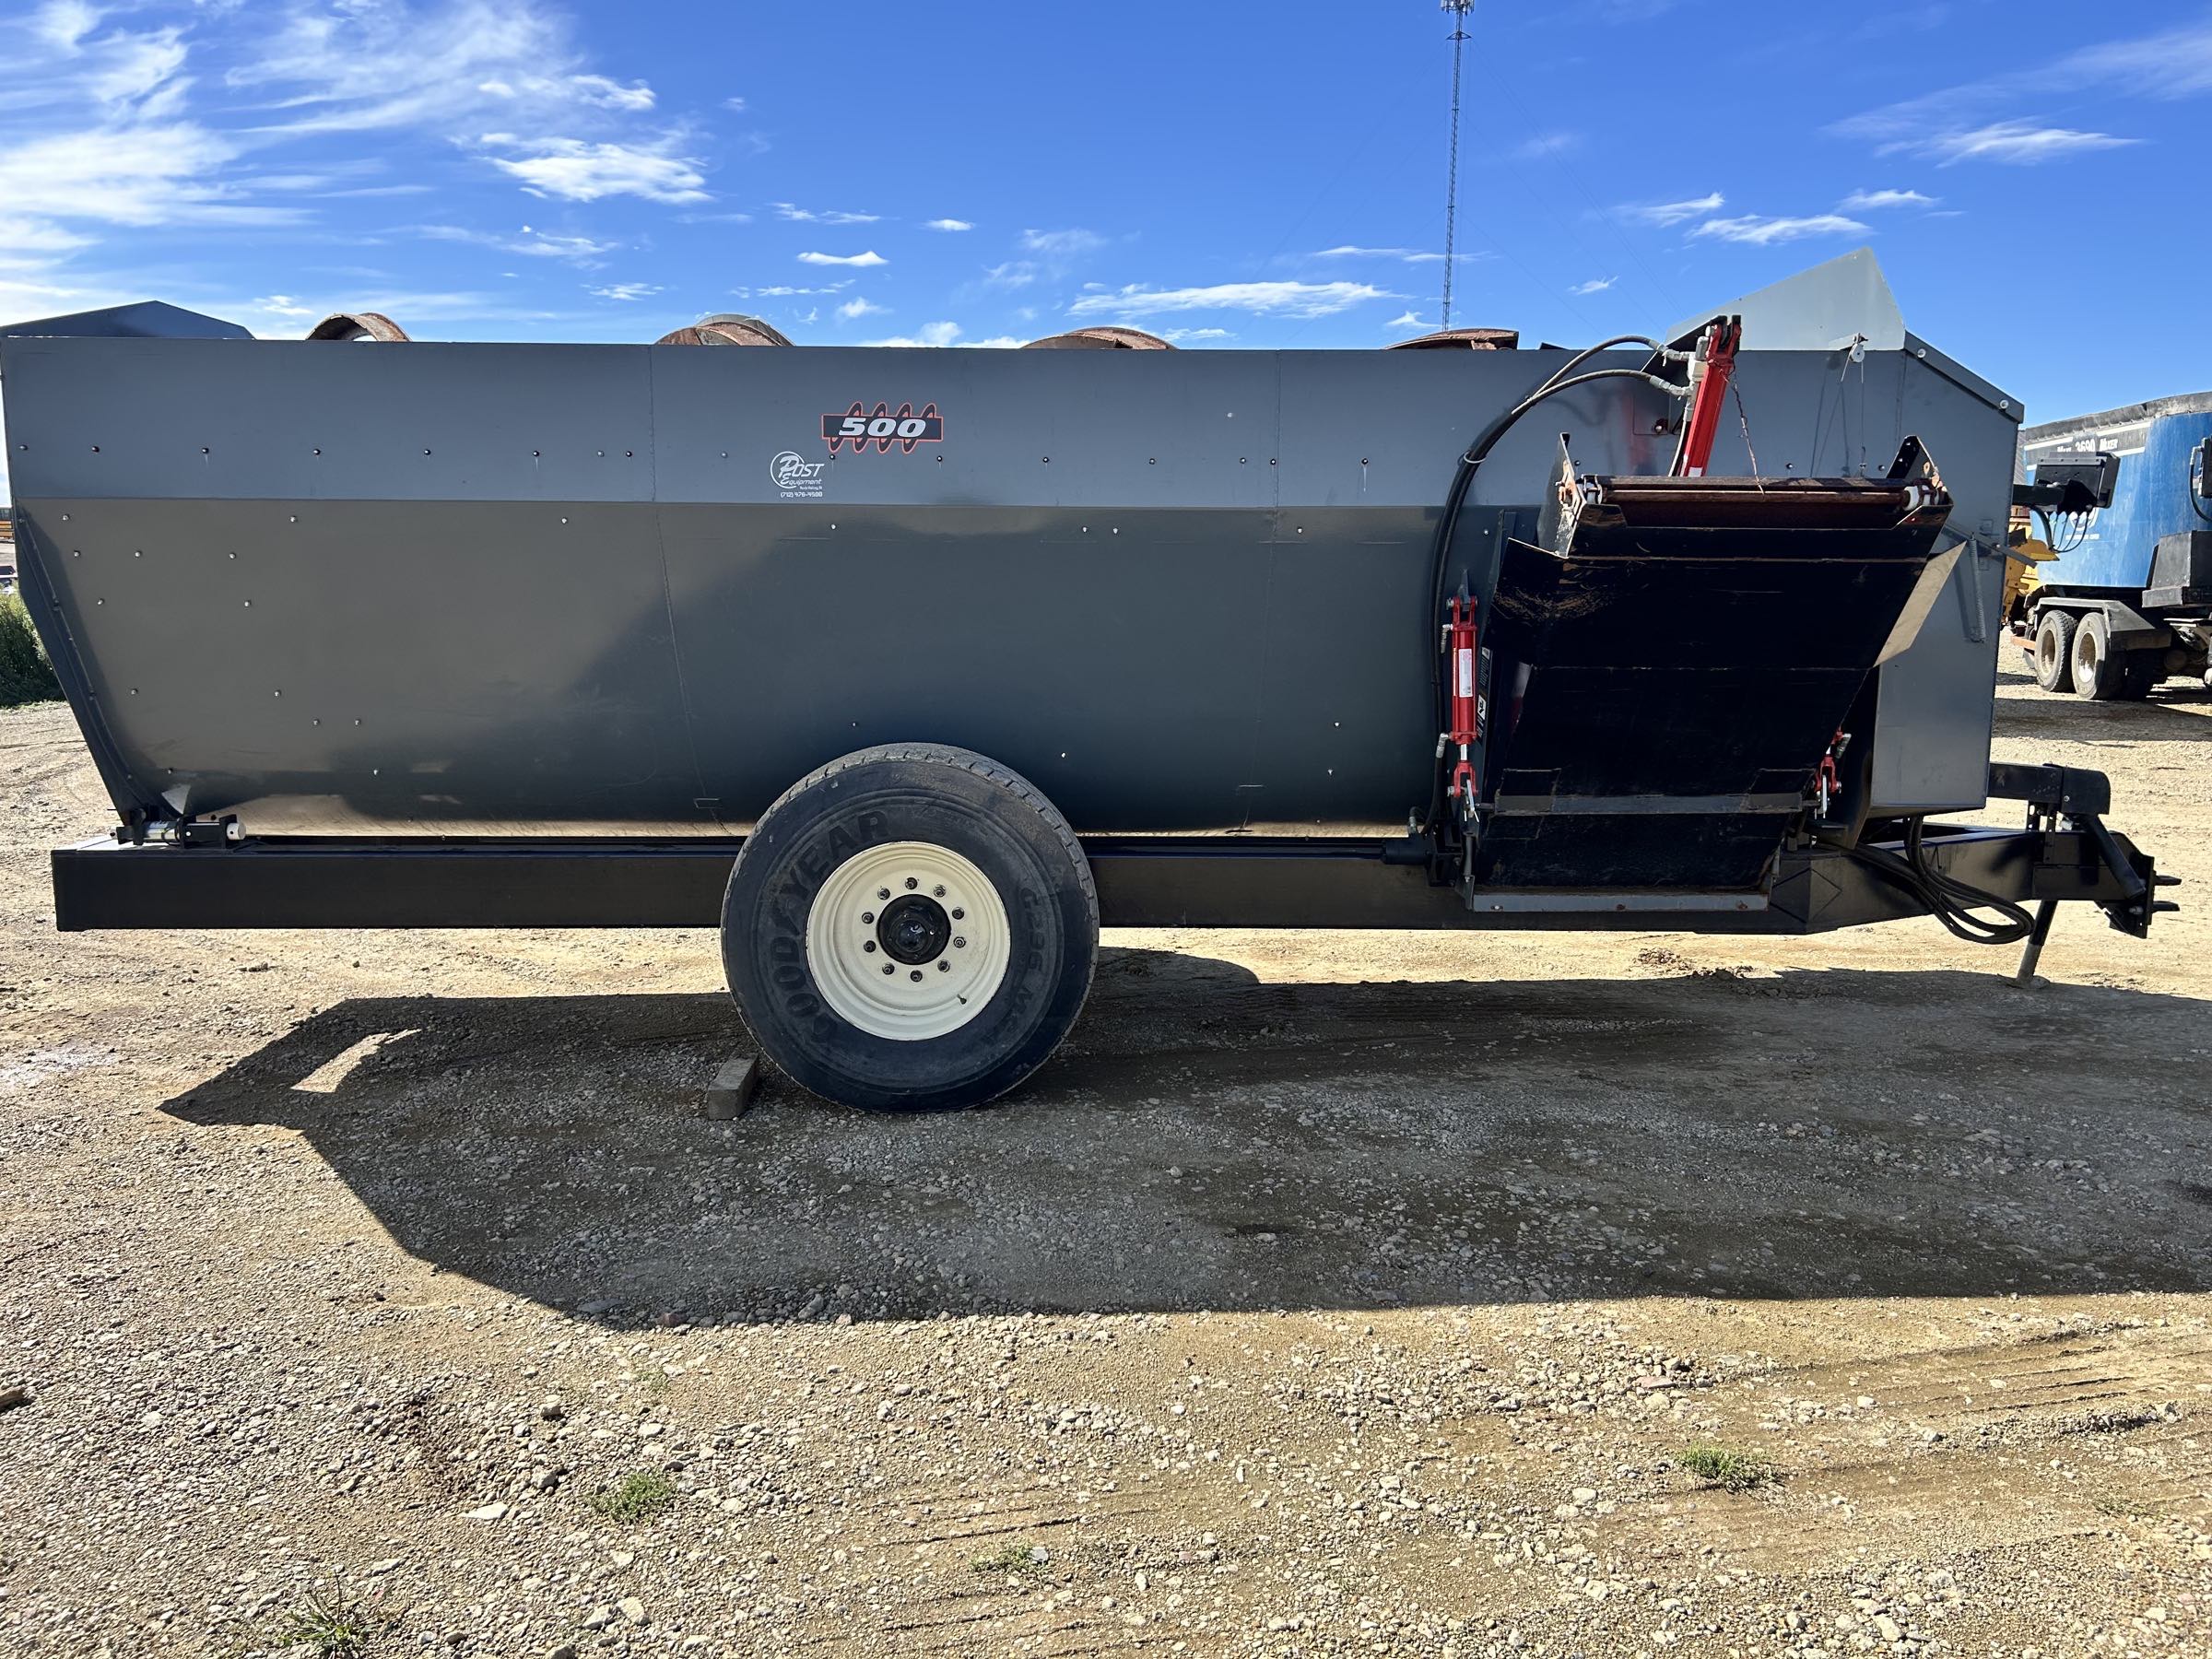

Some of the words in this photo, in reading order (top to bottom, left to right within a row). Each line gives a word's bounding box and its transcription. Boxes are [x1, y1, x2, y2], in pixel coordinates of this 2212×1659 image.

[838, 417, 926, 438] 500
[778, 455, 825, 478] POST
[780, 472, 822, 486] Equipment
[768, 809, 891, 1043] GOODYEAR
